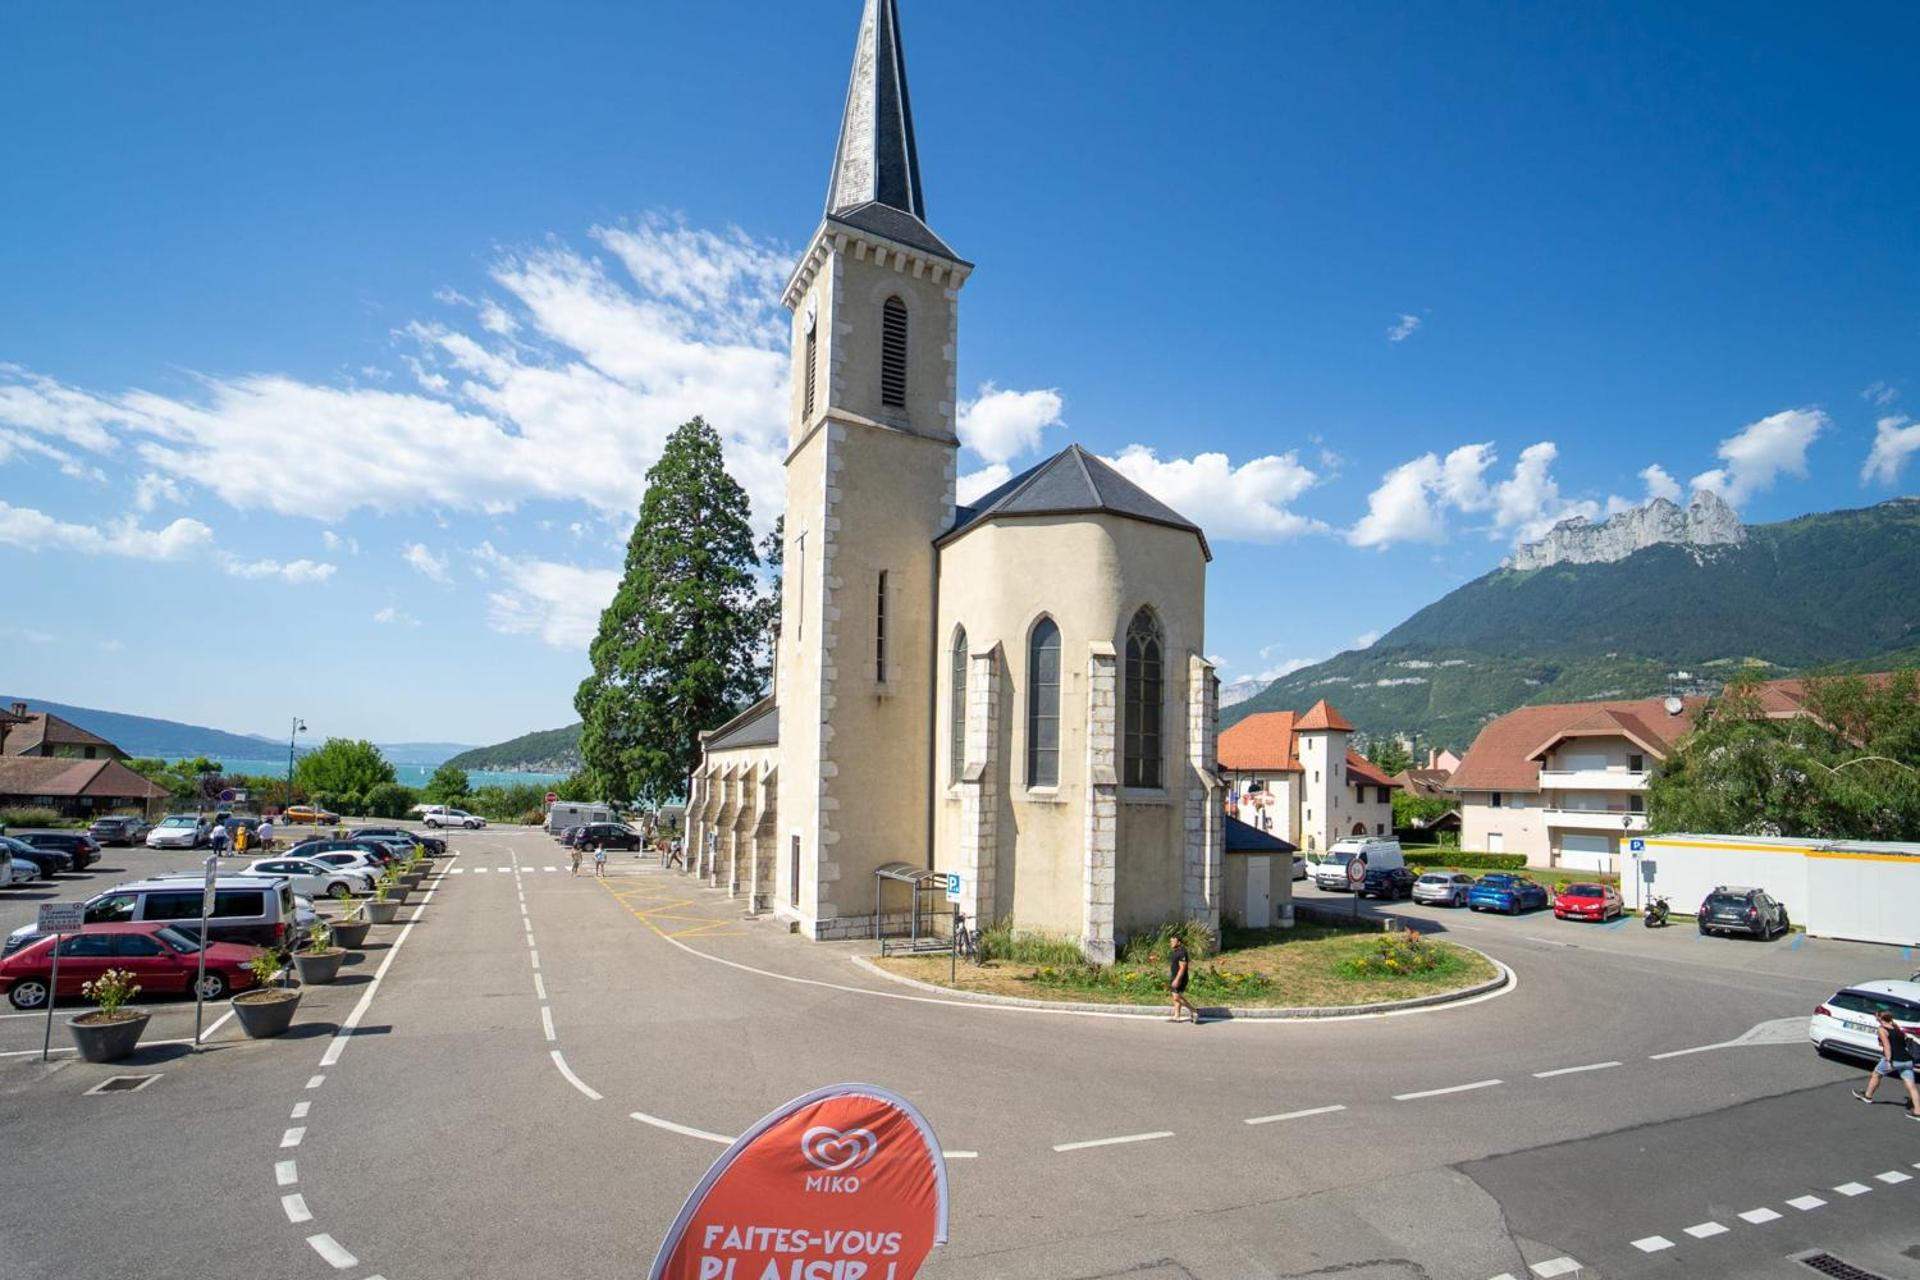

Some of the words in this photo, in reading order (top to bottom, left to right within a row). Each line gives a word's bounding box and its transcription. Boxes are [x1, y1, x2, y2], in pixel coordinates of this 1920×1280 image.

[949, 876, 957, 891] P
[805, 1176, 860, 1193] MIKO
[703, 1225, 902, 1255] FAITES-VOUS
